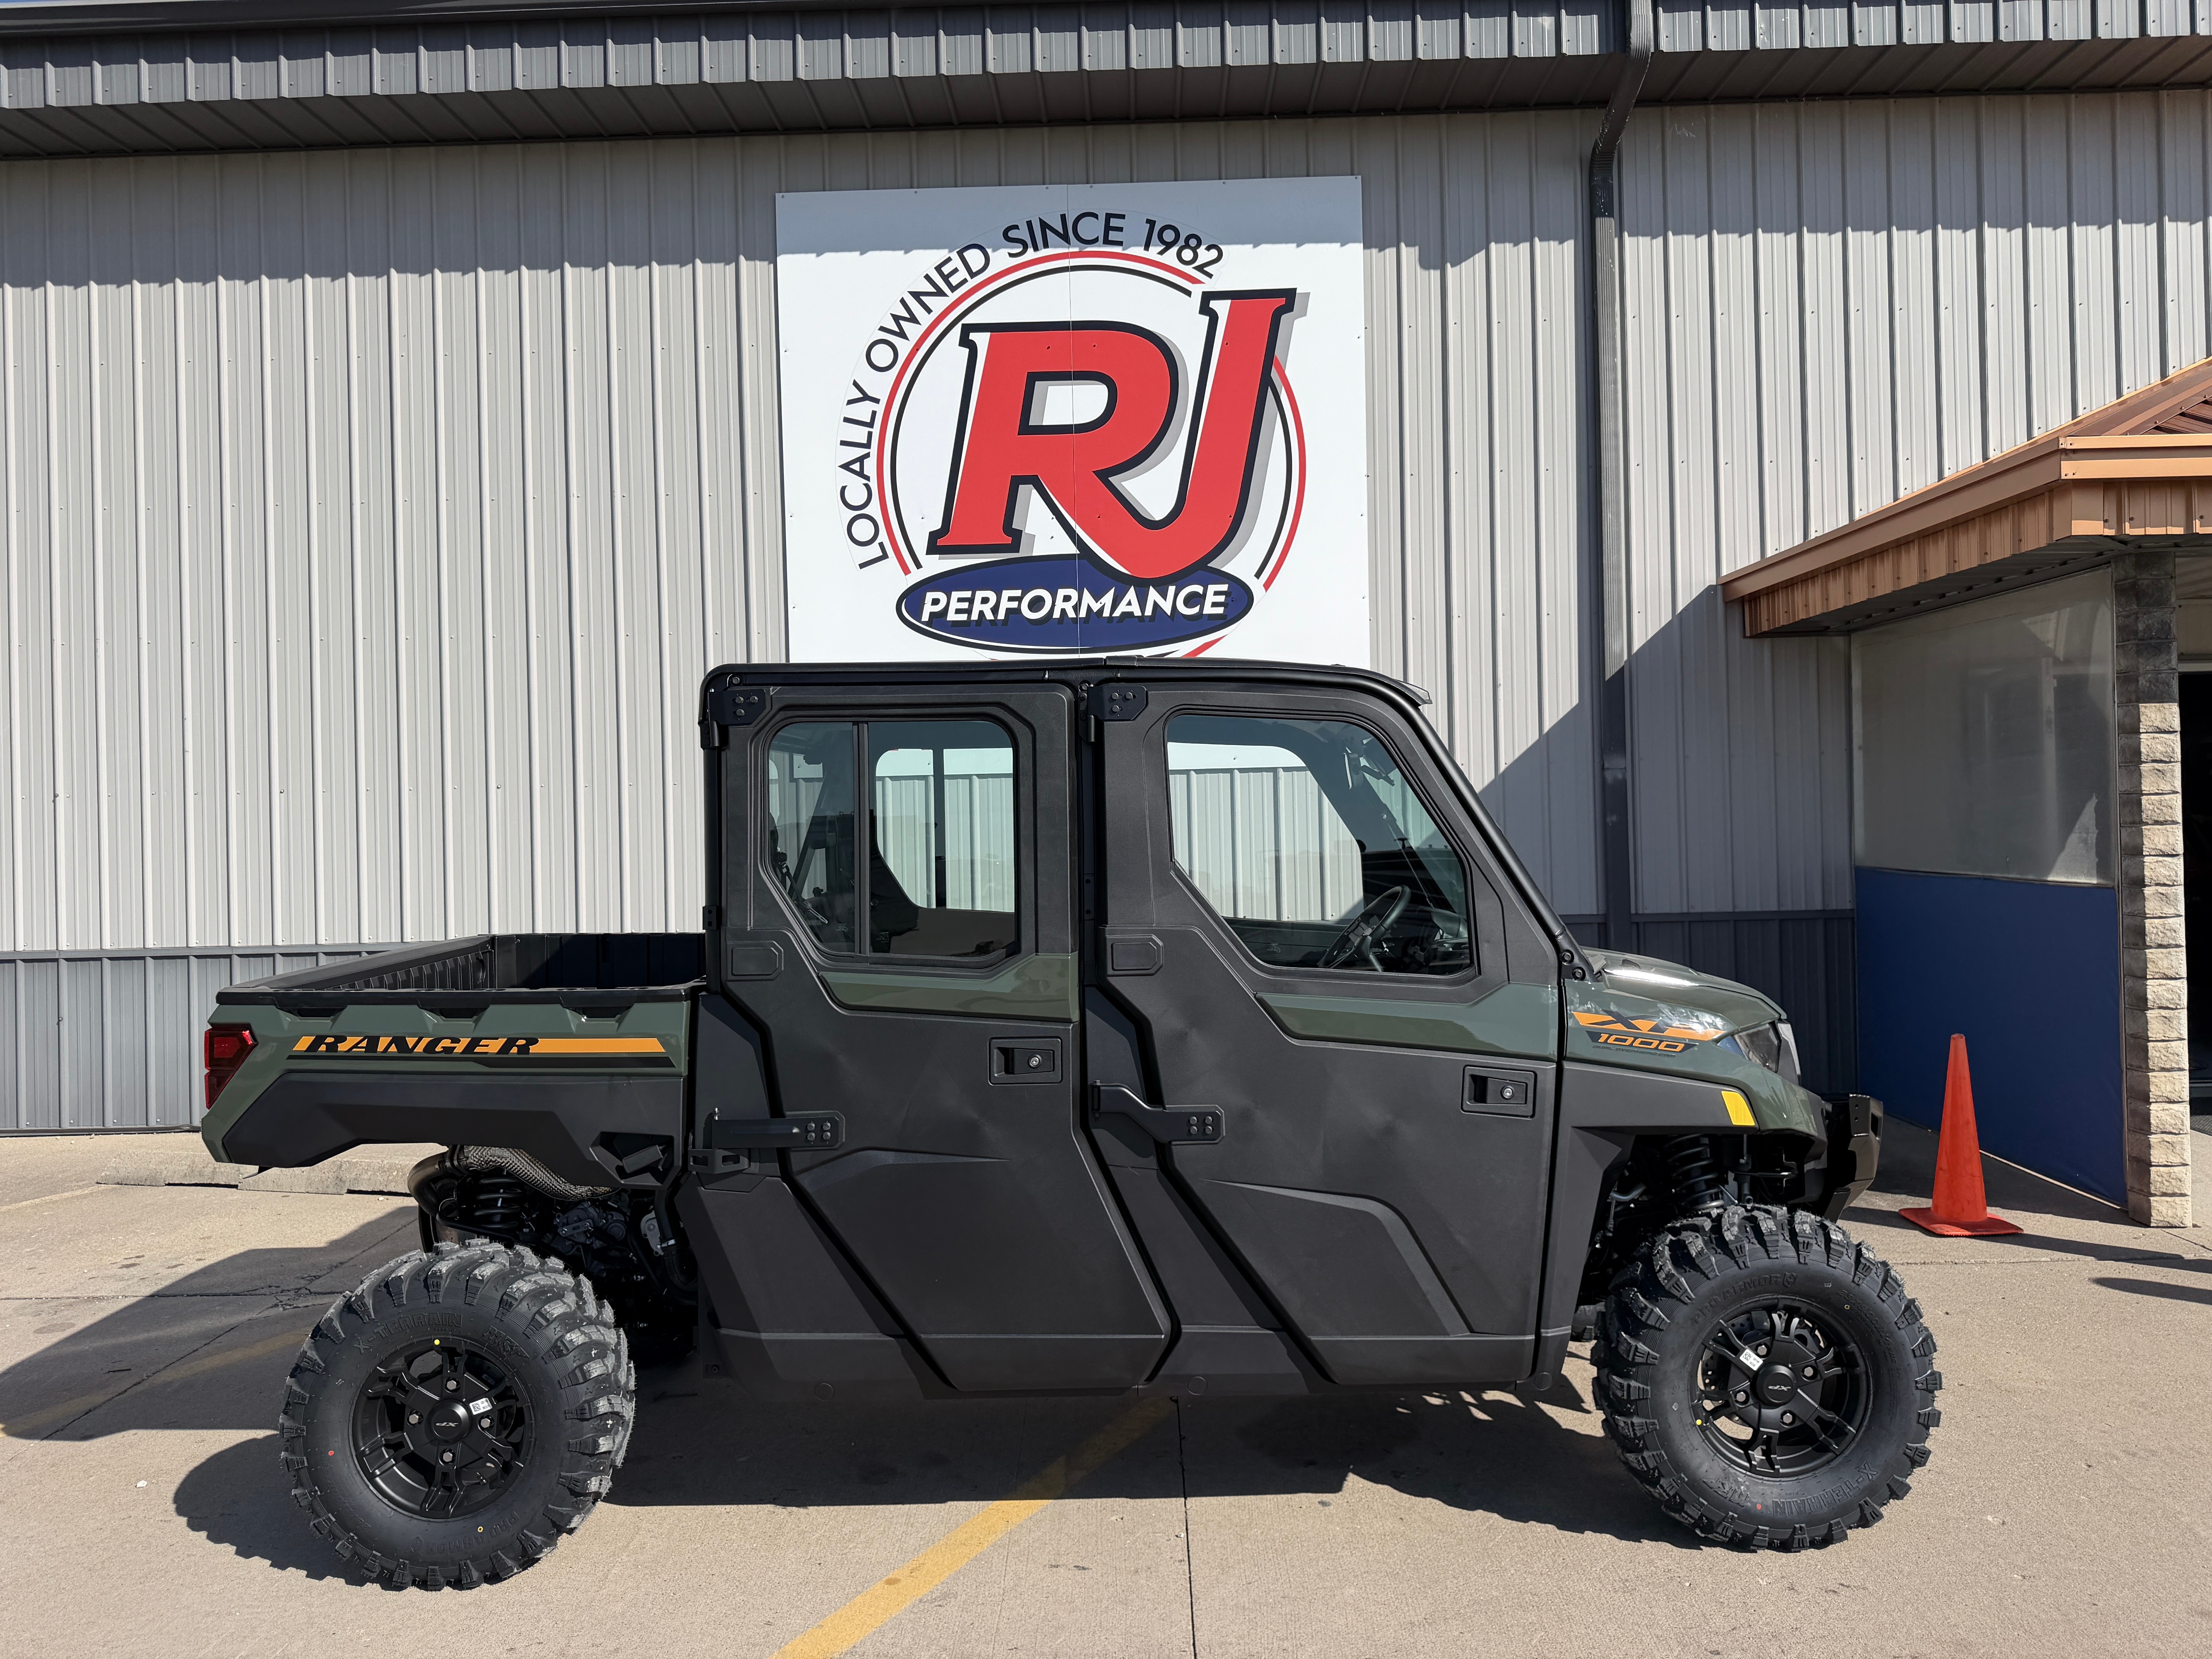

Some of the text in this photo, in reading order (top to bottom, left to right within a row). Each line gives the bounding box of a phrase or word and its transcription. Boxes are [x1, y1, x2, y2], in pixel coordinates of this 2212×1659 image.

[838, 211, 1223, 569] LOCALLY OWNED SINCE 1982
[926, 288, 1297, 586] RJ
[921, 584, 1229, 623] PERFORMANCE
[304, 1034, 541, 1056] RANGER
[1598, 1033, 1685, 1052] 1000
[353, 1312, 462, 1354] X-TERRAIN
[1772, 1461, 1878, 1516] X-TERRAIN
